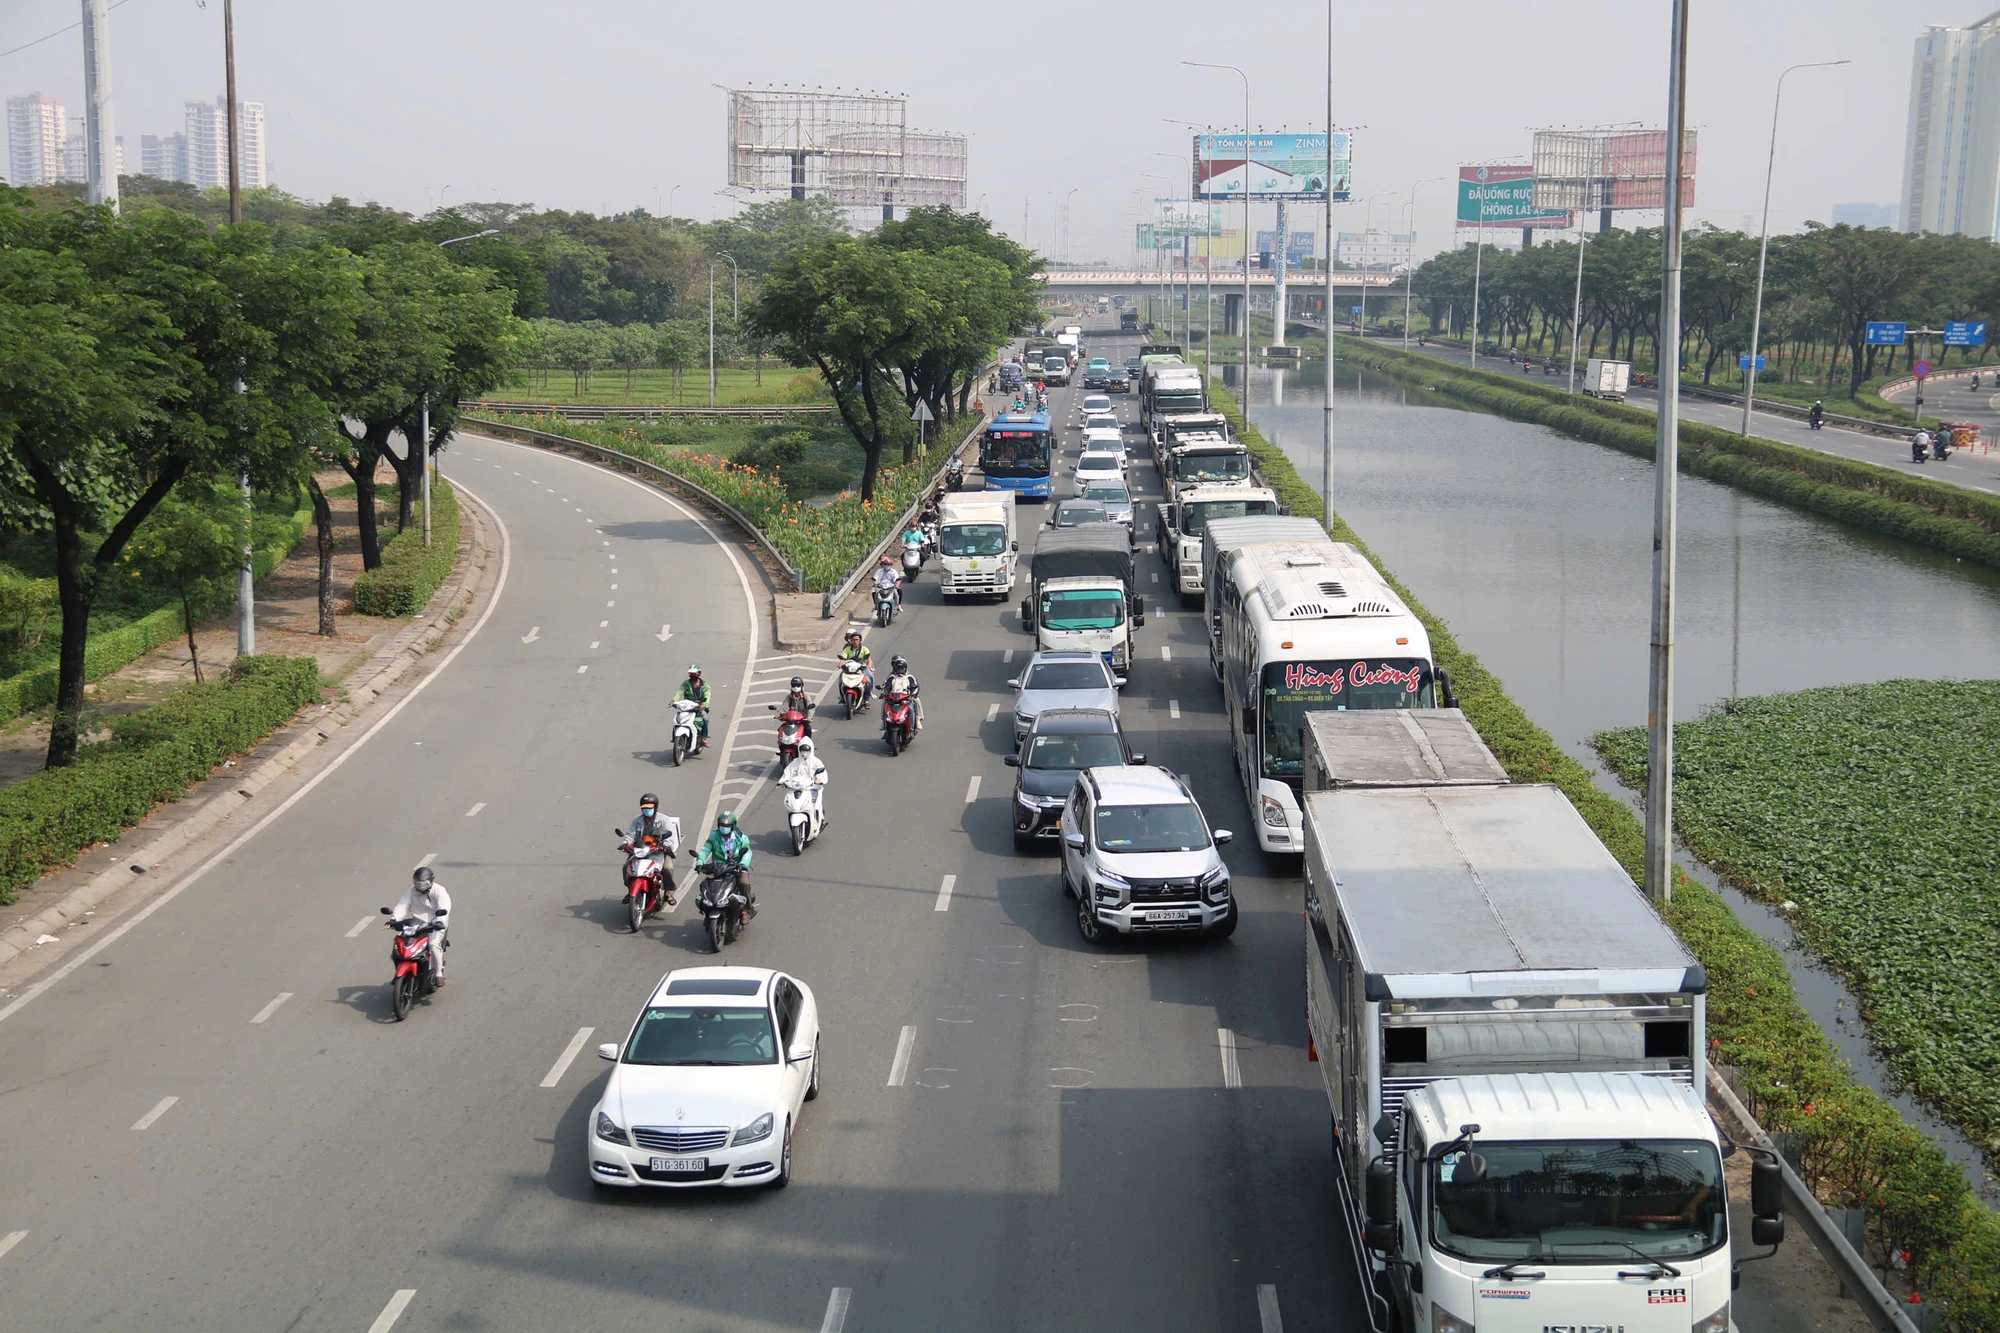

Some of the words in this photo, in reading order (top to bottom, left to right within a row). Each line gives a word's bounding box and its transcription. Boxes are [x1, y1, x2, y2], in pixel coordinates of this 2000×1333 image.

[1218, 139, 1235, 147] TÔN
[1295, 139, 1343, 148] ZINMG
[1468, 187, 1482, 200] ĐÃ
[1484, 186, 1510, 200] UỐNG
[1481, 201, 1513, 215] KHÔNG
[1516, 202, 1531, 215] LÁI
[1296, 236, 1313, 245] Lexi
[1285, 663, 1345, 695] Hùng
[1349, 661, 1420, 693] Cường
[1149, 912, 1185, 920] 66A-257.34
[653, 1160, 704, 1171] 51G-361.60
[1647, 1288, 1686, 1296] FRR
[1647, 1296, 1687, 1304] 650
